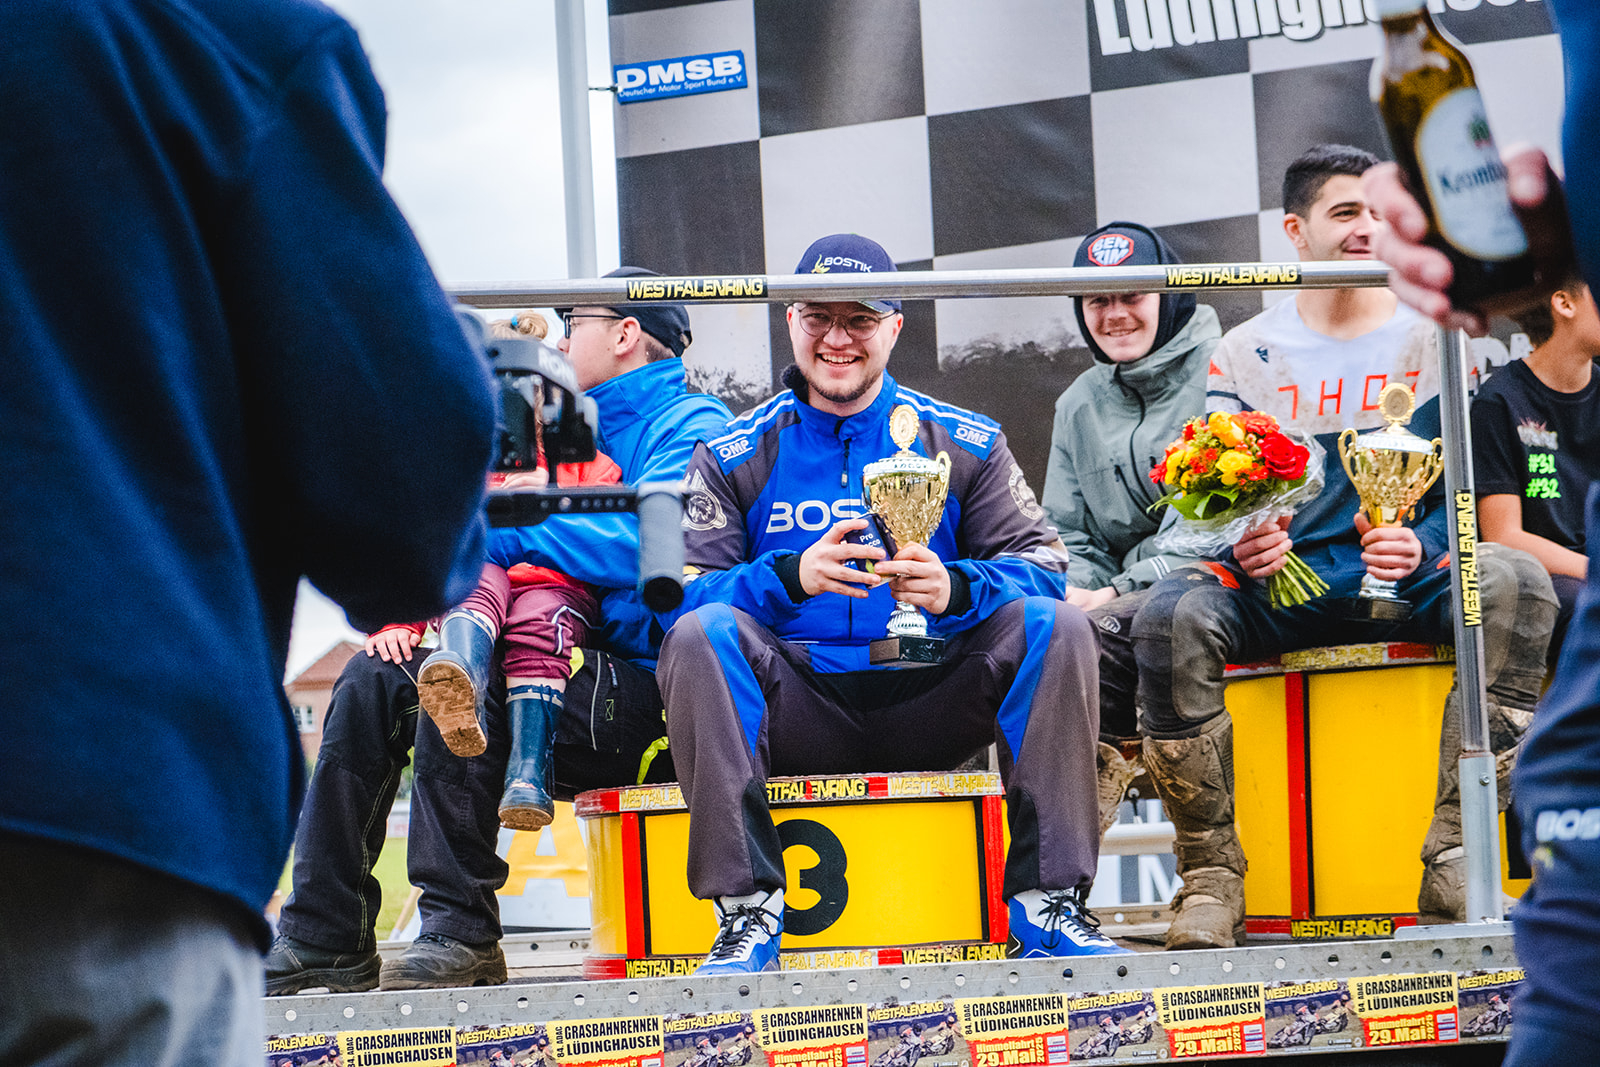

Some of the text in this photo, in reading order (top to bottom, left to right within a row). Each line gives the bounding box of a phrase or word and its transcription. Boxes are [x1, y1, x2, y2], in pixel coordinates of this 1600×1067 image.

[616, 55, 742, 89] DMSB
[619, 85, 655, 97] Deutscher
[658, 83, 681, 93] Motor
[684, 81, 704, 90] Sport
[707, 77, 726, 86] Bund
[824, 256, 872, 272] BOSTIK
[1168, 264, 1298, 285] WESTFALENRING
[628, 278, 763, 299] WESTFALENRING
[955, 427, 989, 444] OMP
[719, 440, 749, 458] OMP
[1528, 453, 1557, 474] #31
[1525, 477, 1561, 499] #32
[765, 498, 865, 533] BOS
[859, 533, 873, 543] Pro
[1456, 492, 1482, 627] WESTFALENRING
[766, 778, 866, 800] STFALENRING
[890, 775, 997, 795] WESTFALENRING
[1535, 808, 1600, 840] BOS
[775, 819, 848, 936] 3
[1291, 920, 1391, 937] WESTFALENRING
[780, 951, 872, 971] TFALENRING
[1170, 984, 1260, 1006] GRASBAHNRENNEN
[1265, 980, 1339, 1000] WESTFALENRING
[1365, 974, 1453, 995] GRASBAHNRENNEN
[972, 995, 1063, 1017] GRASBAHNRENNEN
[1068, 990, 1143, 1010] WESTFALENRING
[1367, 990, 1454, 1010] LÜDINGHAUSEN
[664, 1011, 741, 1032] WESTFALENRING
[770, 1005, 863, 1027] GRASBAHNRENNEN
[869, 1001, 944, 1021] WESTFALENRING
[1172, 1001, 1261, 1022] LÜDINGHAUSEN
[564, 1017, 659, 1040] GRASBAHNRENNEN
[772, 1022, 865, 1043] LÜDINGHAUSEN
[974, 1012, 1065, 1033] LÜDINGHAUSEN
[355, 1029, 451, 1051] GRASBAHNRENNEN
[457, 1023, 535, 1044] WESTFALENRING
[555, 1026, 563, 1044] ADAC
[1369, 1026, 1426, 1045] 29.Mai
[346, 1037, 354, 1055] ADAC
[566, 1034, 660, 1056] LÜDINGHAUSEN
[1174, 1037, 1233, 1056] 29.Mai
[357, 1046, 453, 1067] LÜDINGHAUSEN
[834, 1047, 843, 1067] 025
[976, 1049, 1036, 1067] 29.Mai
